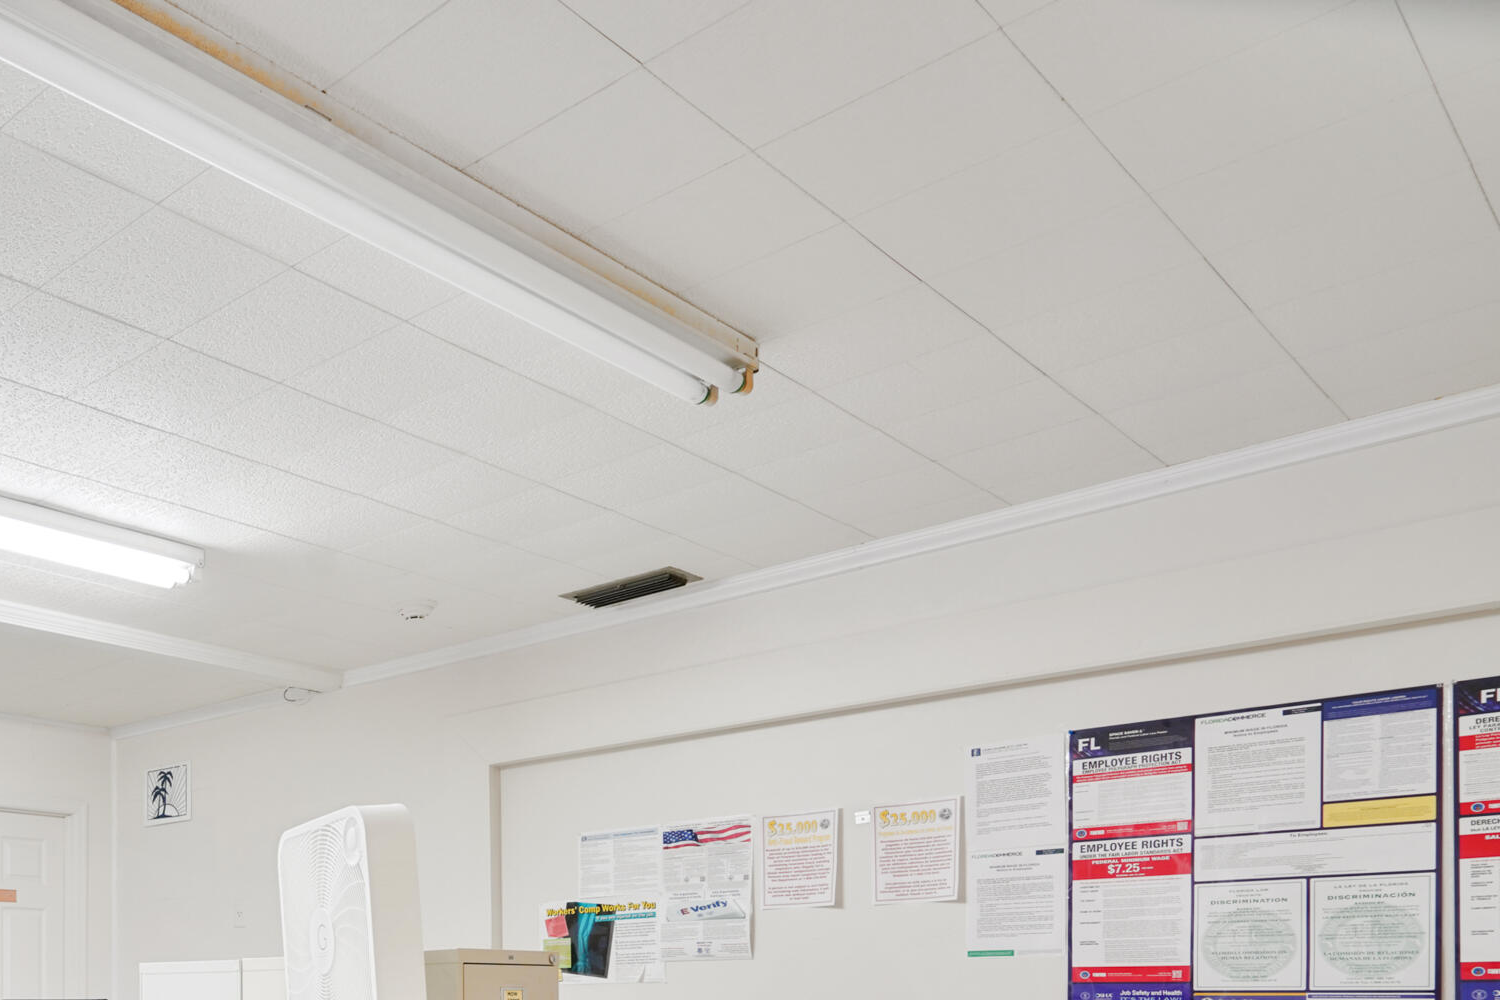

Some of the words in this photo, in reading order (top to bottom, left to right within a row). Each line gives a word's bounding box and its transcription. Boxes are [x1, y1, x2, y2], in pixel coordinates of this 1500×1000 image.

[1077, 736, 1102, 753] FL
[1082, 756, 1138, 771] EMPLOYEE
[1141, 751, 1182, 764] RIGHTS
[1080, 840, 1137, 854] EMPLOYEE
[1141, 837, 1183, 849] RIGHTS
[1107, 863, 1140, 875] $7.25
[1210, 897, 1288, 905] DISCRIMINATION
[1327, 892, 1416, 901] DISCRIMINACIÓN
[546, 907, 578, 916] Workers'
[579, 905, 601, 915] Comp
[601, 903, 627, 912] Works
[628, 902, 641, 910] For
[641, 900, 657, 909] You
